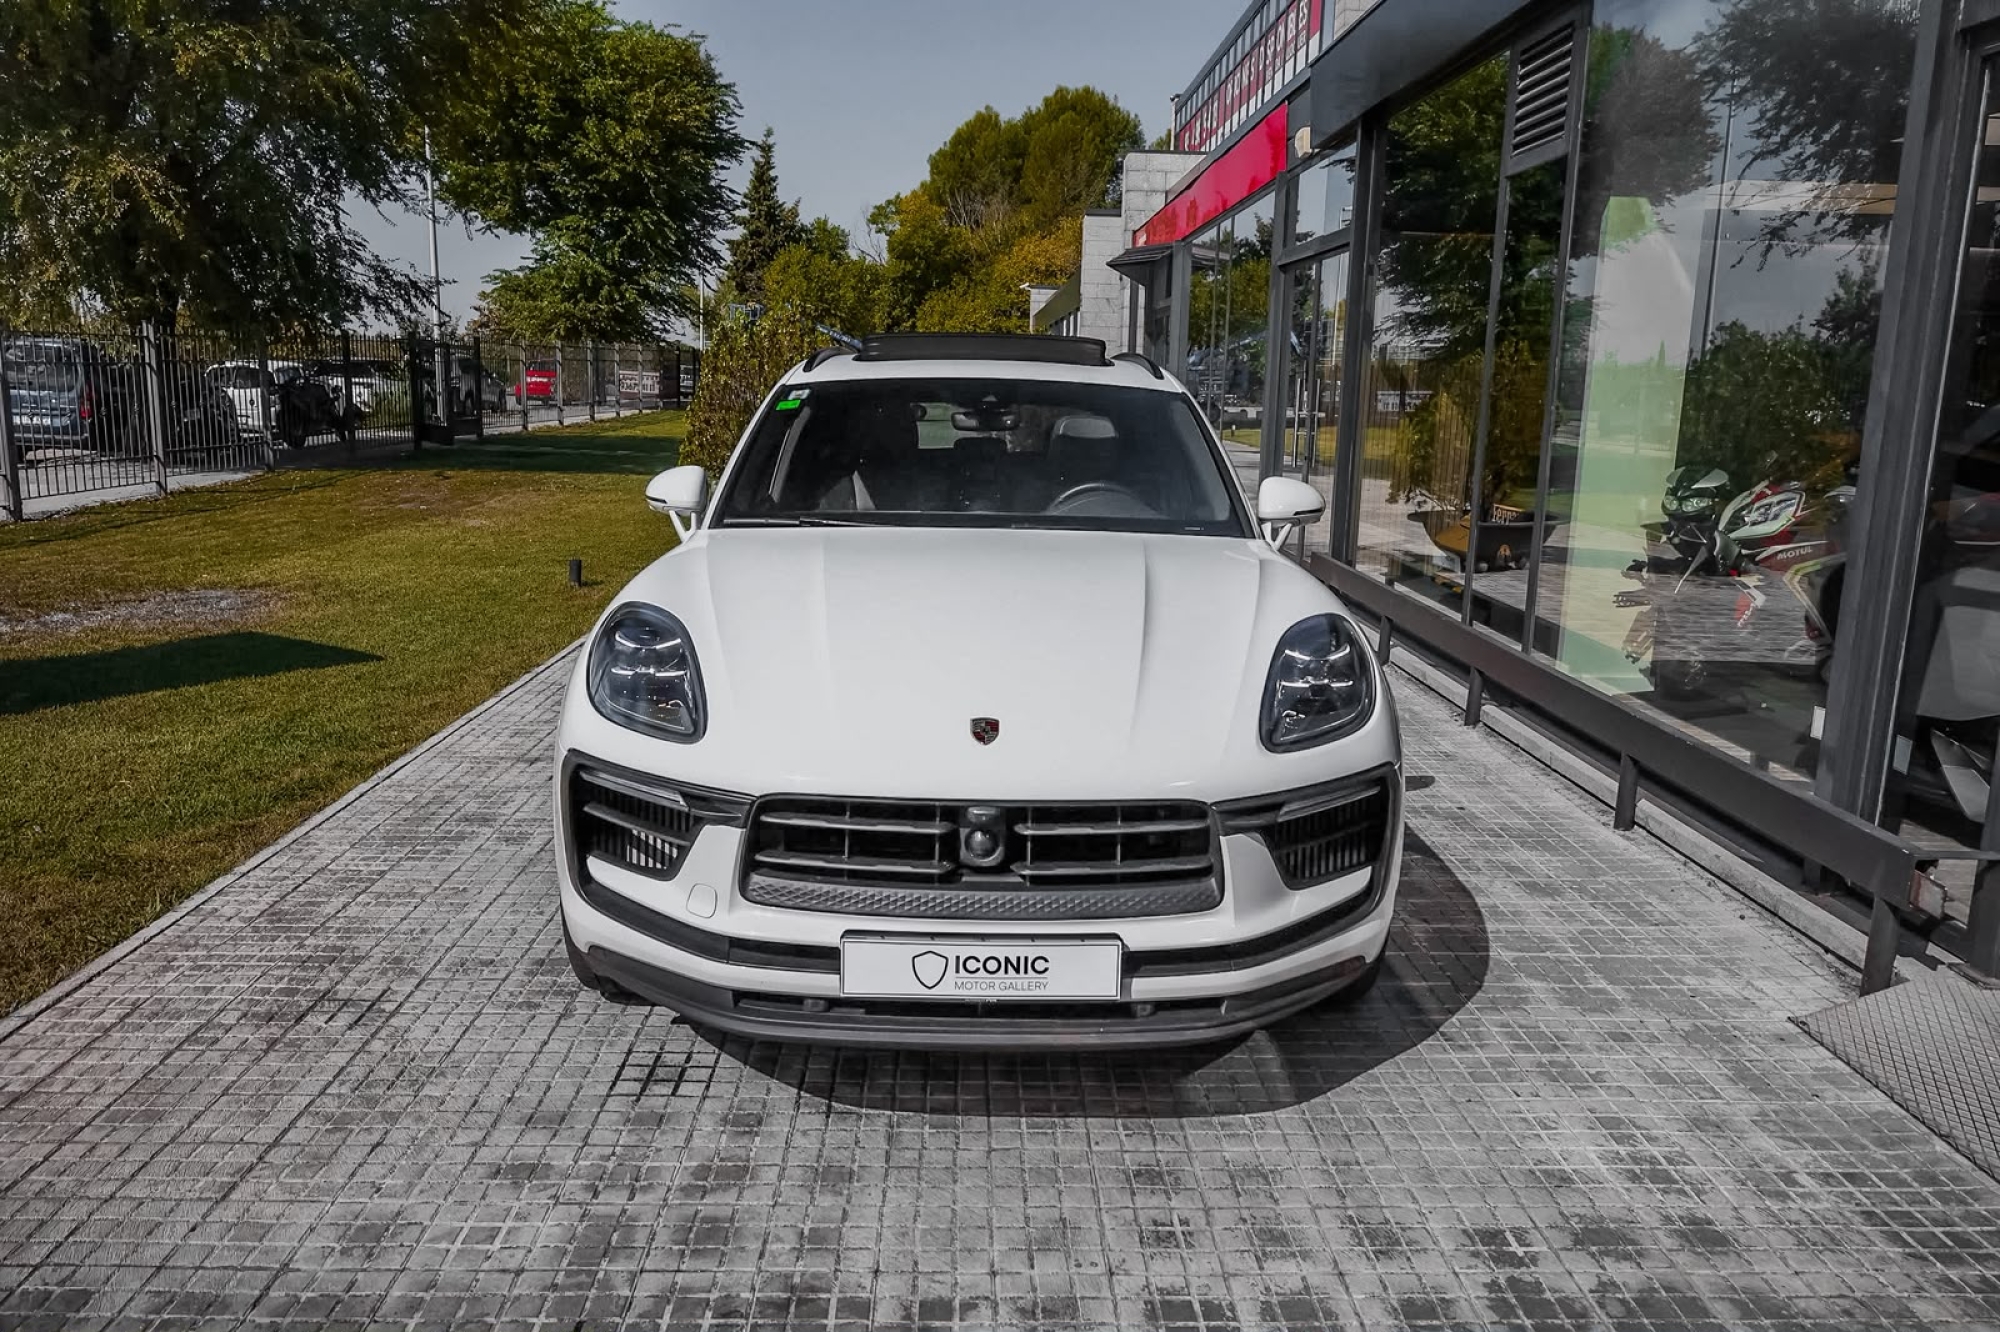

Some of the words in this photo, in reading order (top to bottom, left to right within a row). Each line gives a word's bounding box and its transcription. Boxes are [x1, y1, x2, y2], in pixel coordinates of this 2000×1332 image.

[1776, 545, 1813, 560] MOTUL
[954, 955, 1050, 976] ICONIC
[954, 980, 996, 991] MOTOR
[998, 980, 1049, 992] GALLERY
